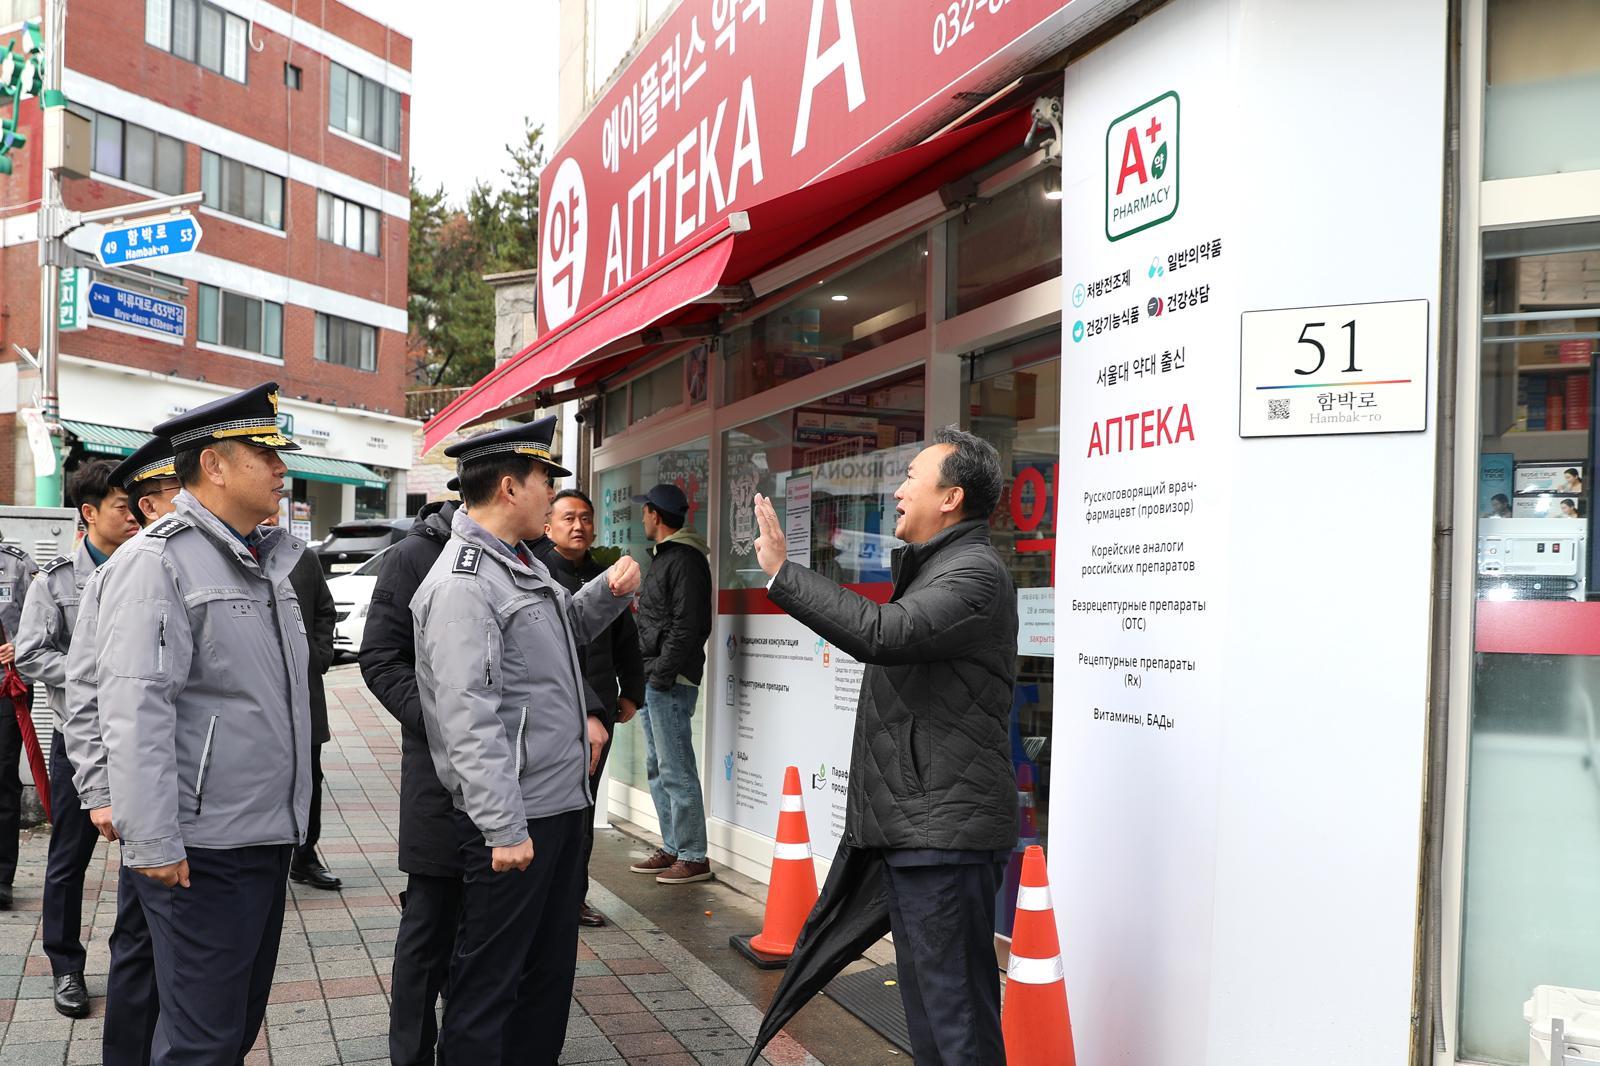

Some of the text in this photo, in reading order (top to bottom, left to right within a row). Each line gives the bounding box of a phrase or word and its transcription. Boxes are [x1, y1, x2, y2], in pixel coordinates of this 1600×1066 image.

[1116, 116, 1162, 195] A+
[1154, 153, 1165, 170] 약
[602, 75, 763, 297] АПТЕКА
[1113, 185, 1171, 222] PHARMACY
[127, 225, 168, 246] 함박로
[180, 228, 193, 242] 53
[104, 241, 118, 254] 49
[125, 244, 169, 260] Hambak-ro
[550, 185, 579, 309] 약
[1167, 238, 1222, 272] 일반의약품
[1087, 269, 1131, 299] 처방전조제
[1167, 283, 1210, 313] 건강상담
[1087, 305, 1140, 338] 건강기능식품
[1294, 319, 1363, 376] 51
[1096, 346, 1186, 387] 서울대 약대 출신
[1317, 391, 1378, 412] 함박로
[1309, 411, 1382, 424] Hambak-ro
[1087, 403, 1195, 458] АПТЕКА
[1084, 479, 1197, 507] Русскоговорящий врач-
[1085, 499, 1194, 524] фармацевт (провизор)
[1091, 540, 1184, 559] Корейские аналоги
[1081, 560, 1195, 578] российских препаратов
[1072, 599, 1206, 615] Безрецептурные препараты
[1078, 653, 1196, 673] Рецептурные препараты
[1124, 674, 1142, 689] (Rx)
[1093, 708, 1175, 730] Витамины, БАДы
